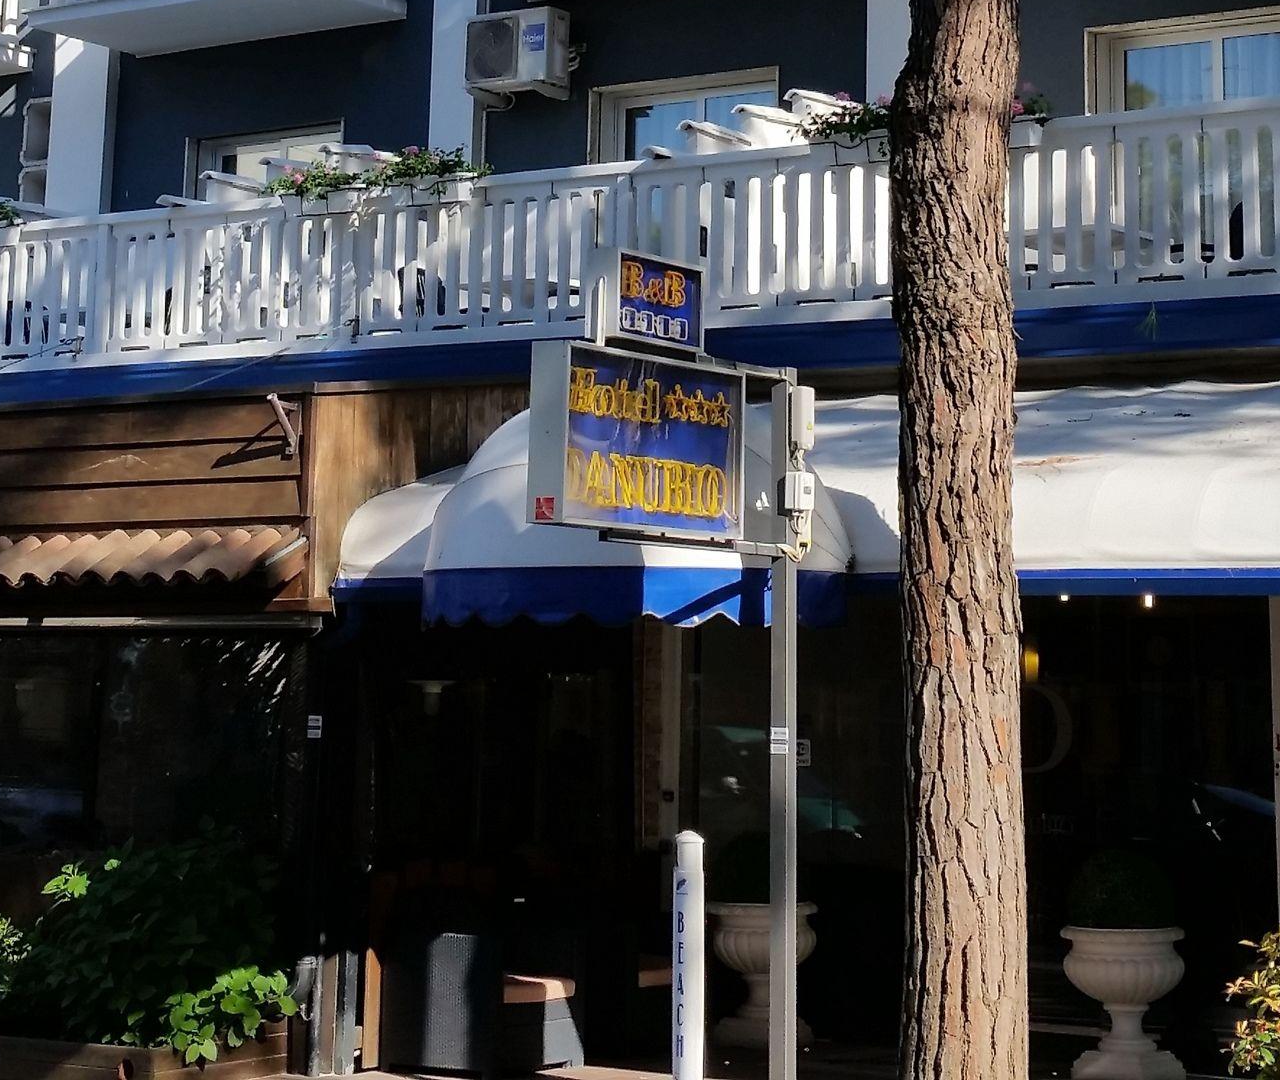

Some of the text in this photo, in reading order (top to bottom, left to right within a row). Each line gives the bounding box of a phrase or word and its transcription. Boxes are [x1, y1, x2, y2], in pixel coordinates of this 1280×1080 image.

[621, 260, 687, 308] B&B
[568, 366, 662, 424] Hotel
[567, 446, 729, 518] DANUBIO
[675, 910, 685, 1058] BEACH
